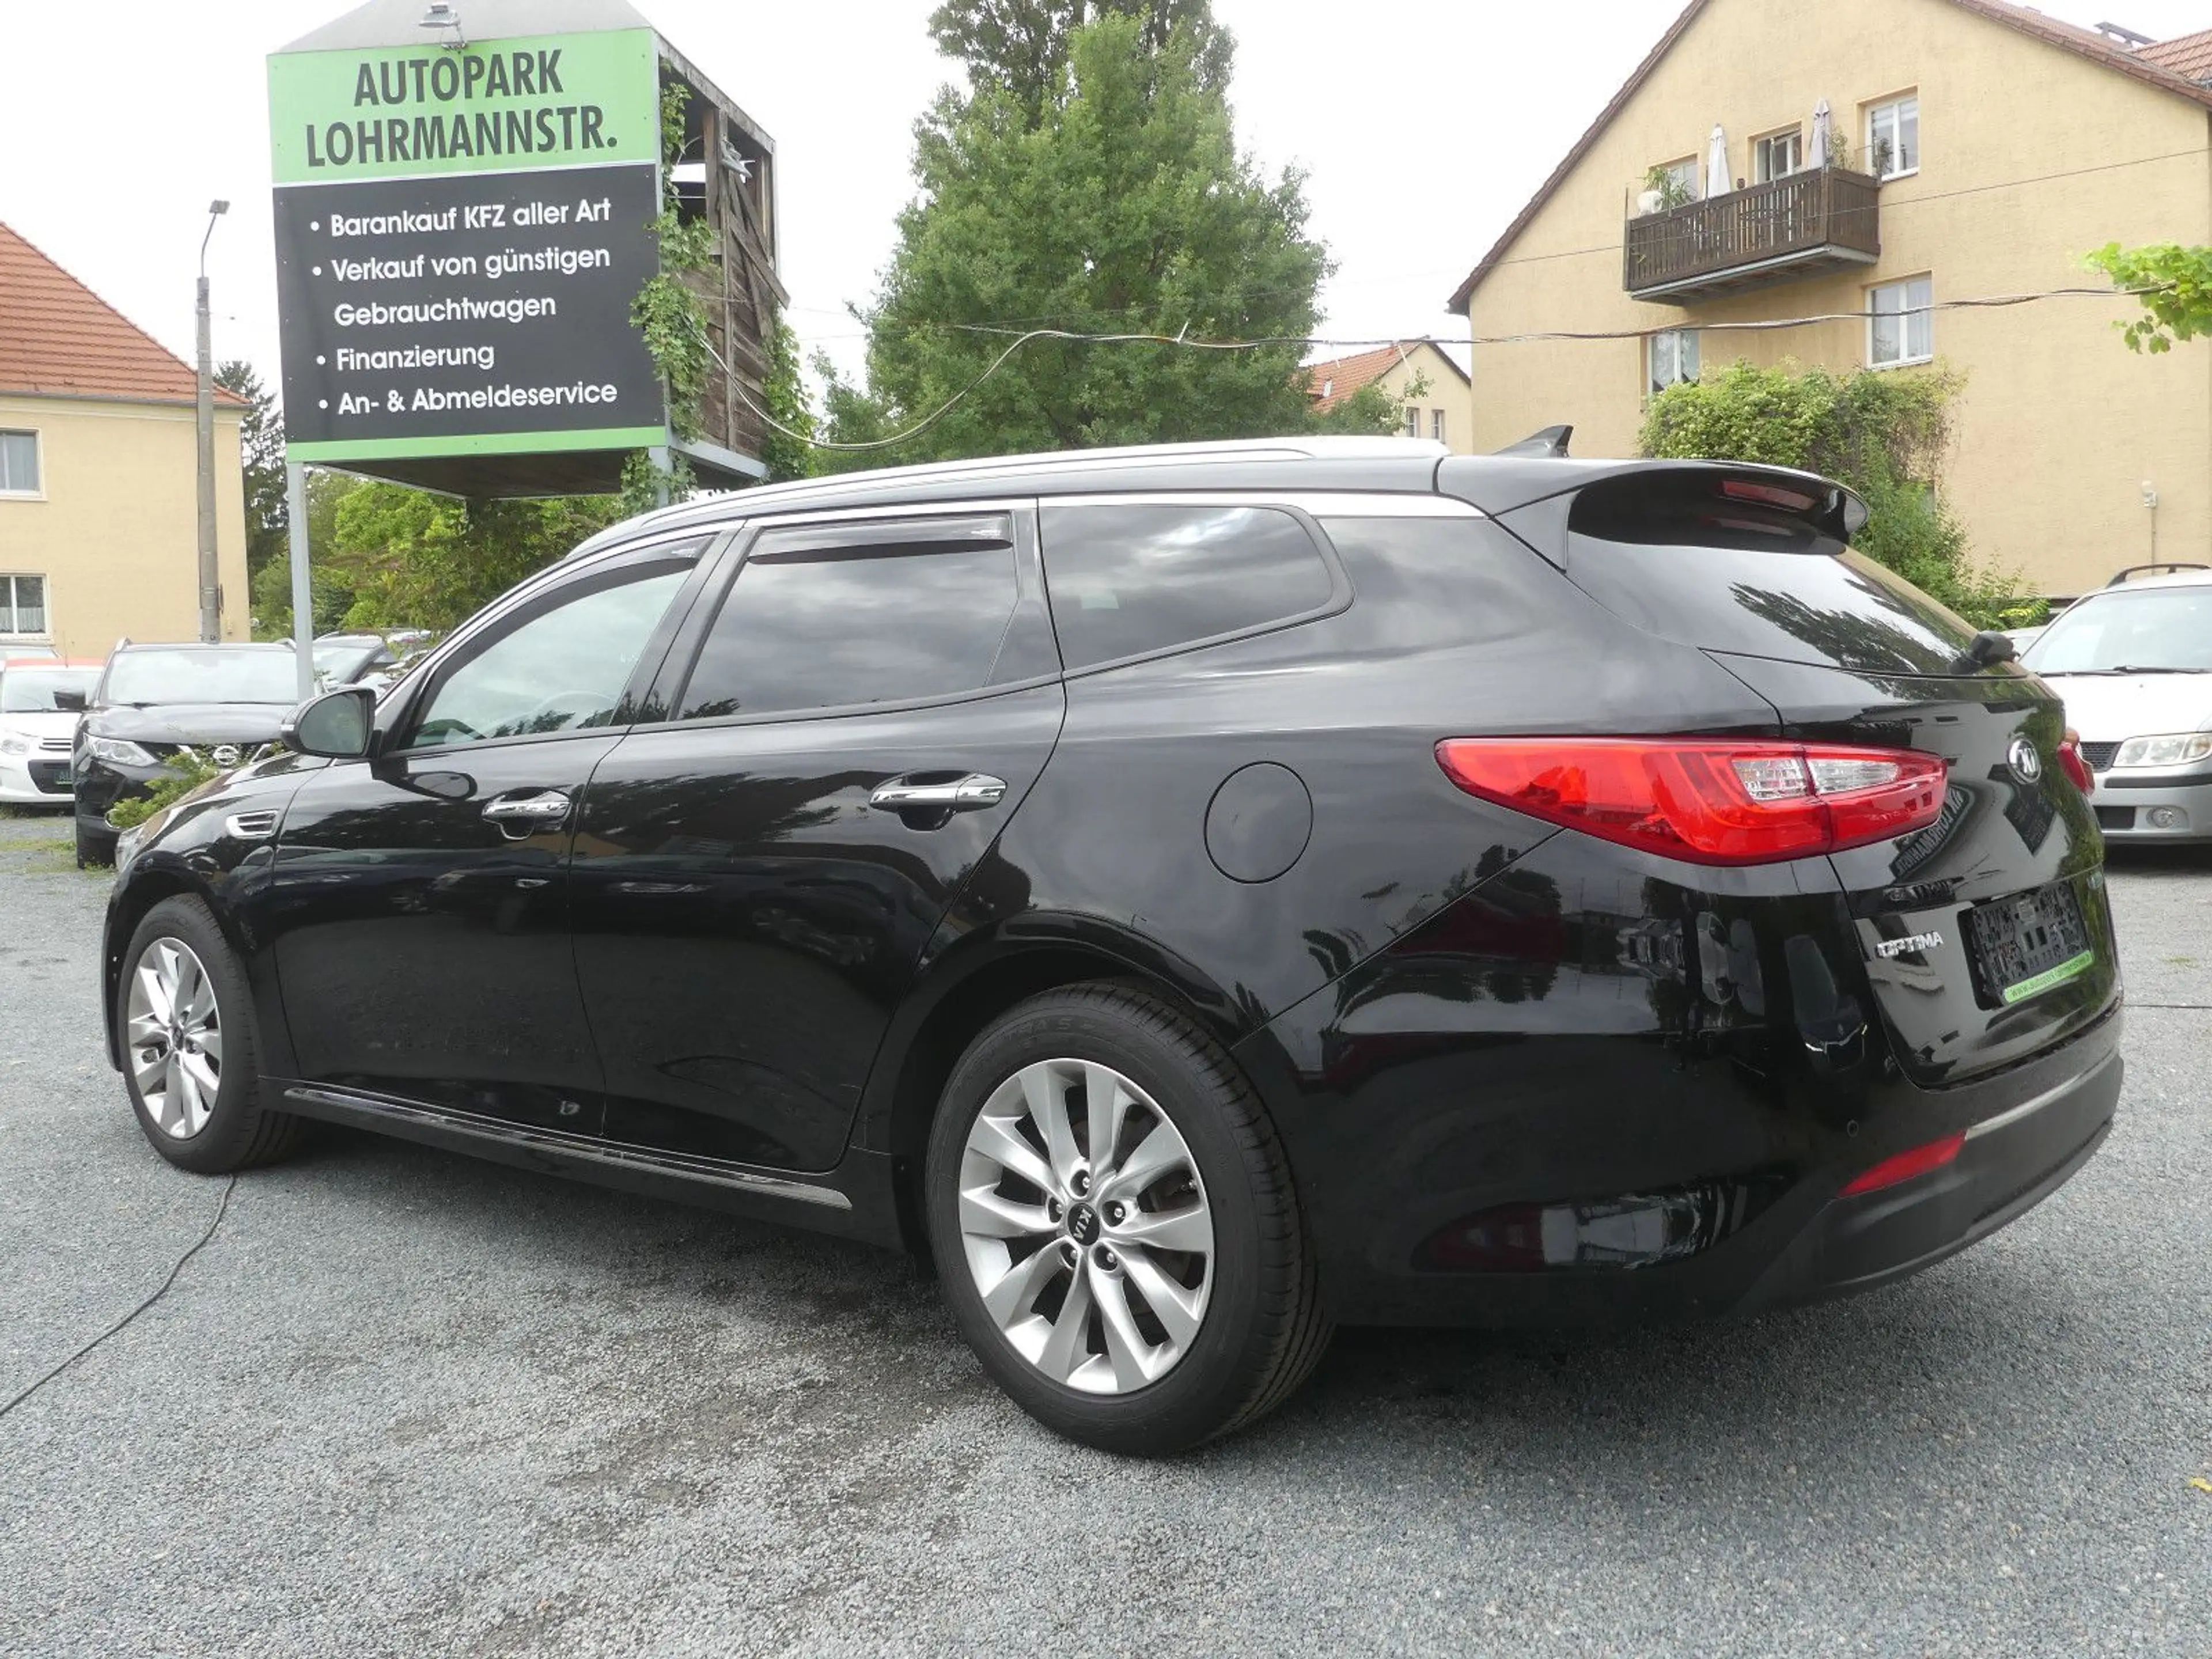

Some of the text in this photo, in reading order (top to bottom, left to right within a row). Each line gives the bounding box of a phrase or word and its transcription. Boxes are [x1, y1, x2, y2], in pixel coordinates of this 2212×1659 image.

[354, 49, 563, 107] AUTOPARK
[306, 105, 618, 167] LOHRMANNSTR.
[331, 198, 611, 237] Barankauf KFZ aller Art
[331, 247, 611, 282] Verkauf von günstigen
[334, 296, 556, 327] Gebrauchtwagen
[336, 344, 494, 371] Finanzierung
[338, 381, 618, 415] An- & Abmeldeservice
[1876, 931, 1944, 958] OPTIMA
[1073, 1208, 1092, 1240] KIA
